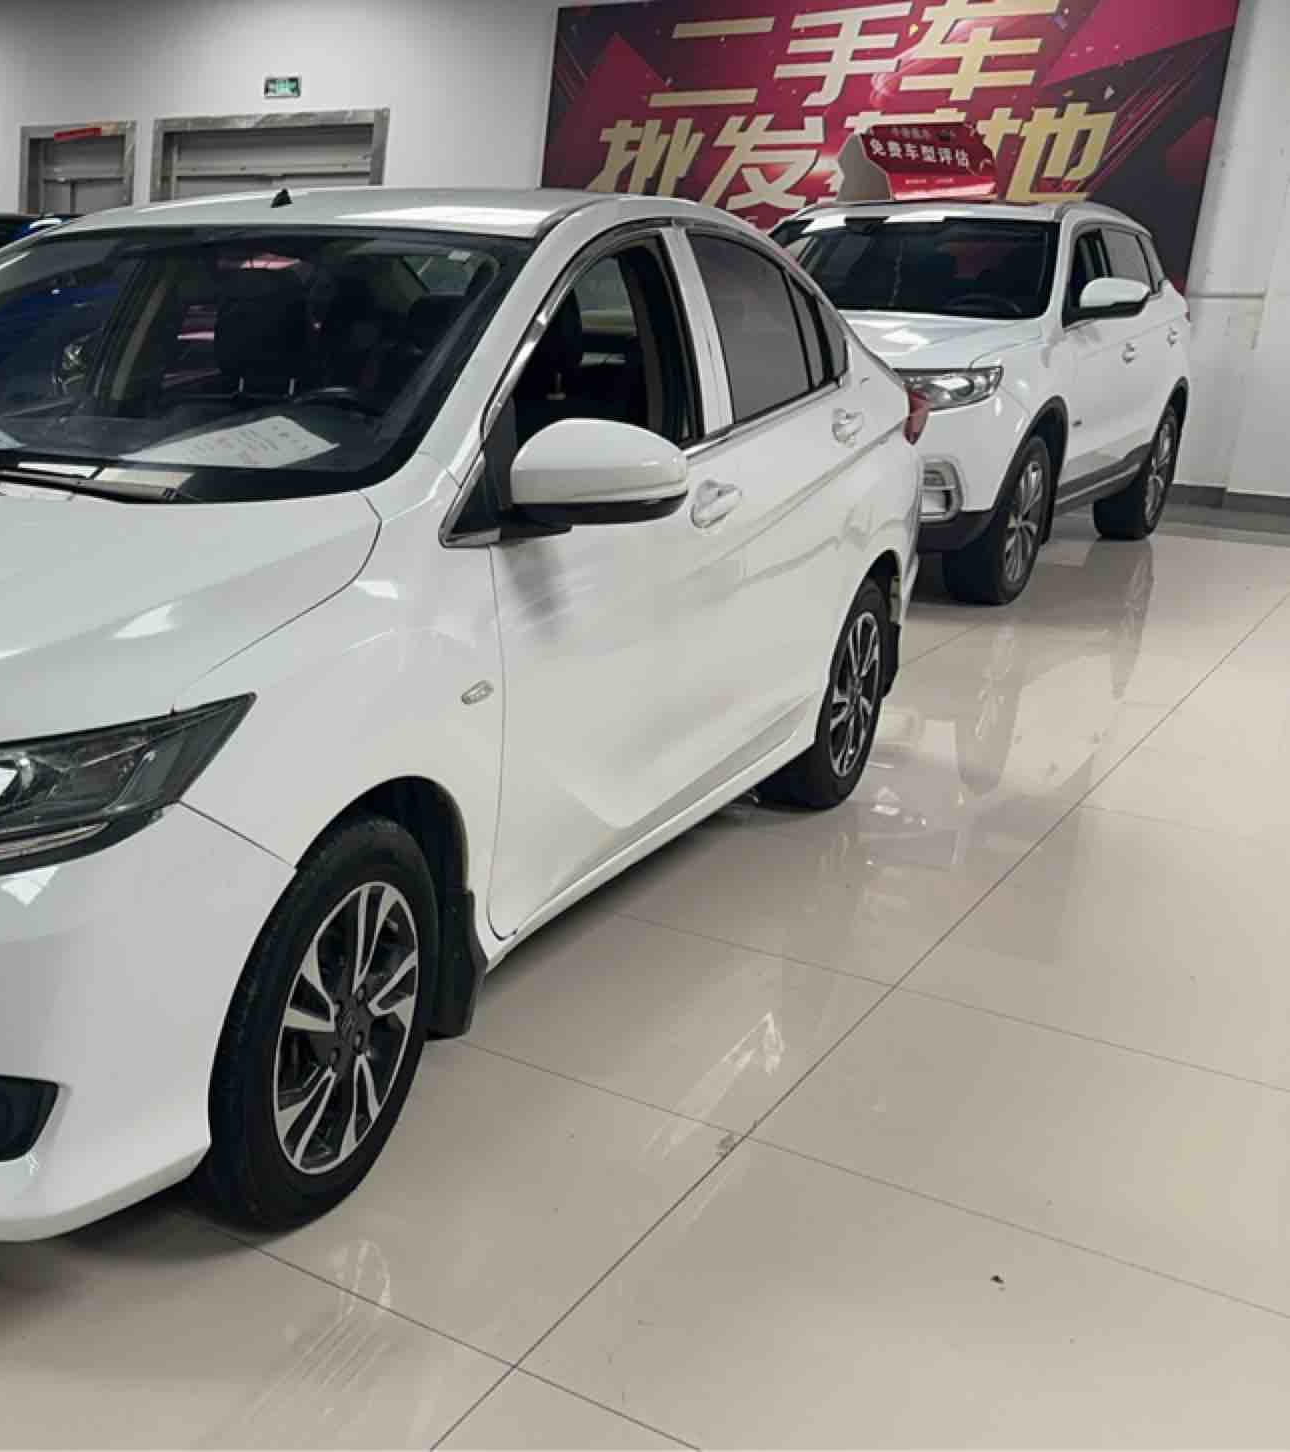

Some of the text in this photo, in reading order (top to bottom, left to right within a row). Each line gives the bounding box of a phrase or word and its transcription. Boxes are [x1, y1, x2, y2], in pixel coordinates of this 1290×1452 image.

[648, 0, 1059, 107] 二手车
[869, 136, 970, 168] 免费车型评估
